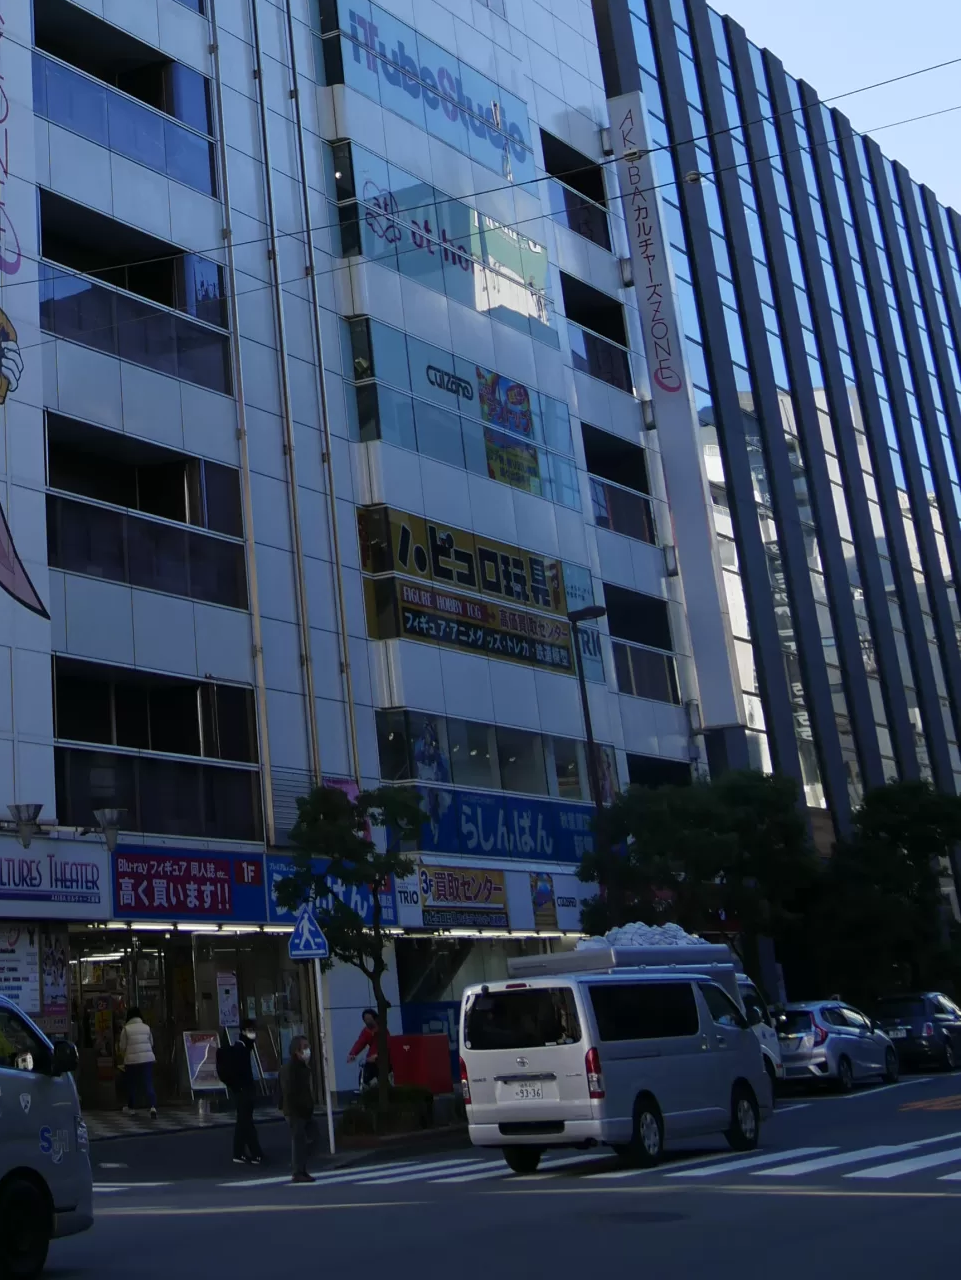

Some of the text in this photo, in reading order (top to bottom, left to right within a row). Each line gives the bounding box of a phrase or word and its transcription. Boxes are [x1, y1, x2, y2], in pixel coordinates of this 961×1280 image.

[618, 108, 675, 380] AKBAカルチャーズZONE
[403, 586, 482, 620] FIGURE HOBBY TCG
[461, 803, 554, 856] らしんばん
[47, 854, 101, 891] THEATER
[118, 858, 148, 875] Blu-ray
[150, 860, 188, 877] フィギュア
[190, 861, 216, 878] 同人誌
[242, 861, 256, 884] 1F
[398, 890, 419, 905] TRIO
[420, 869, 503, 903] 3F 買取センター
